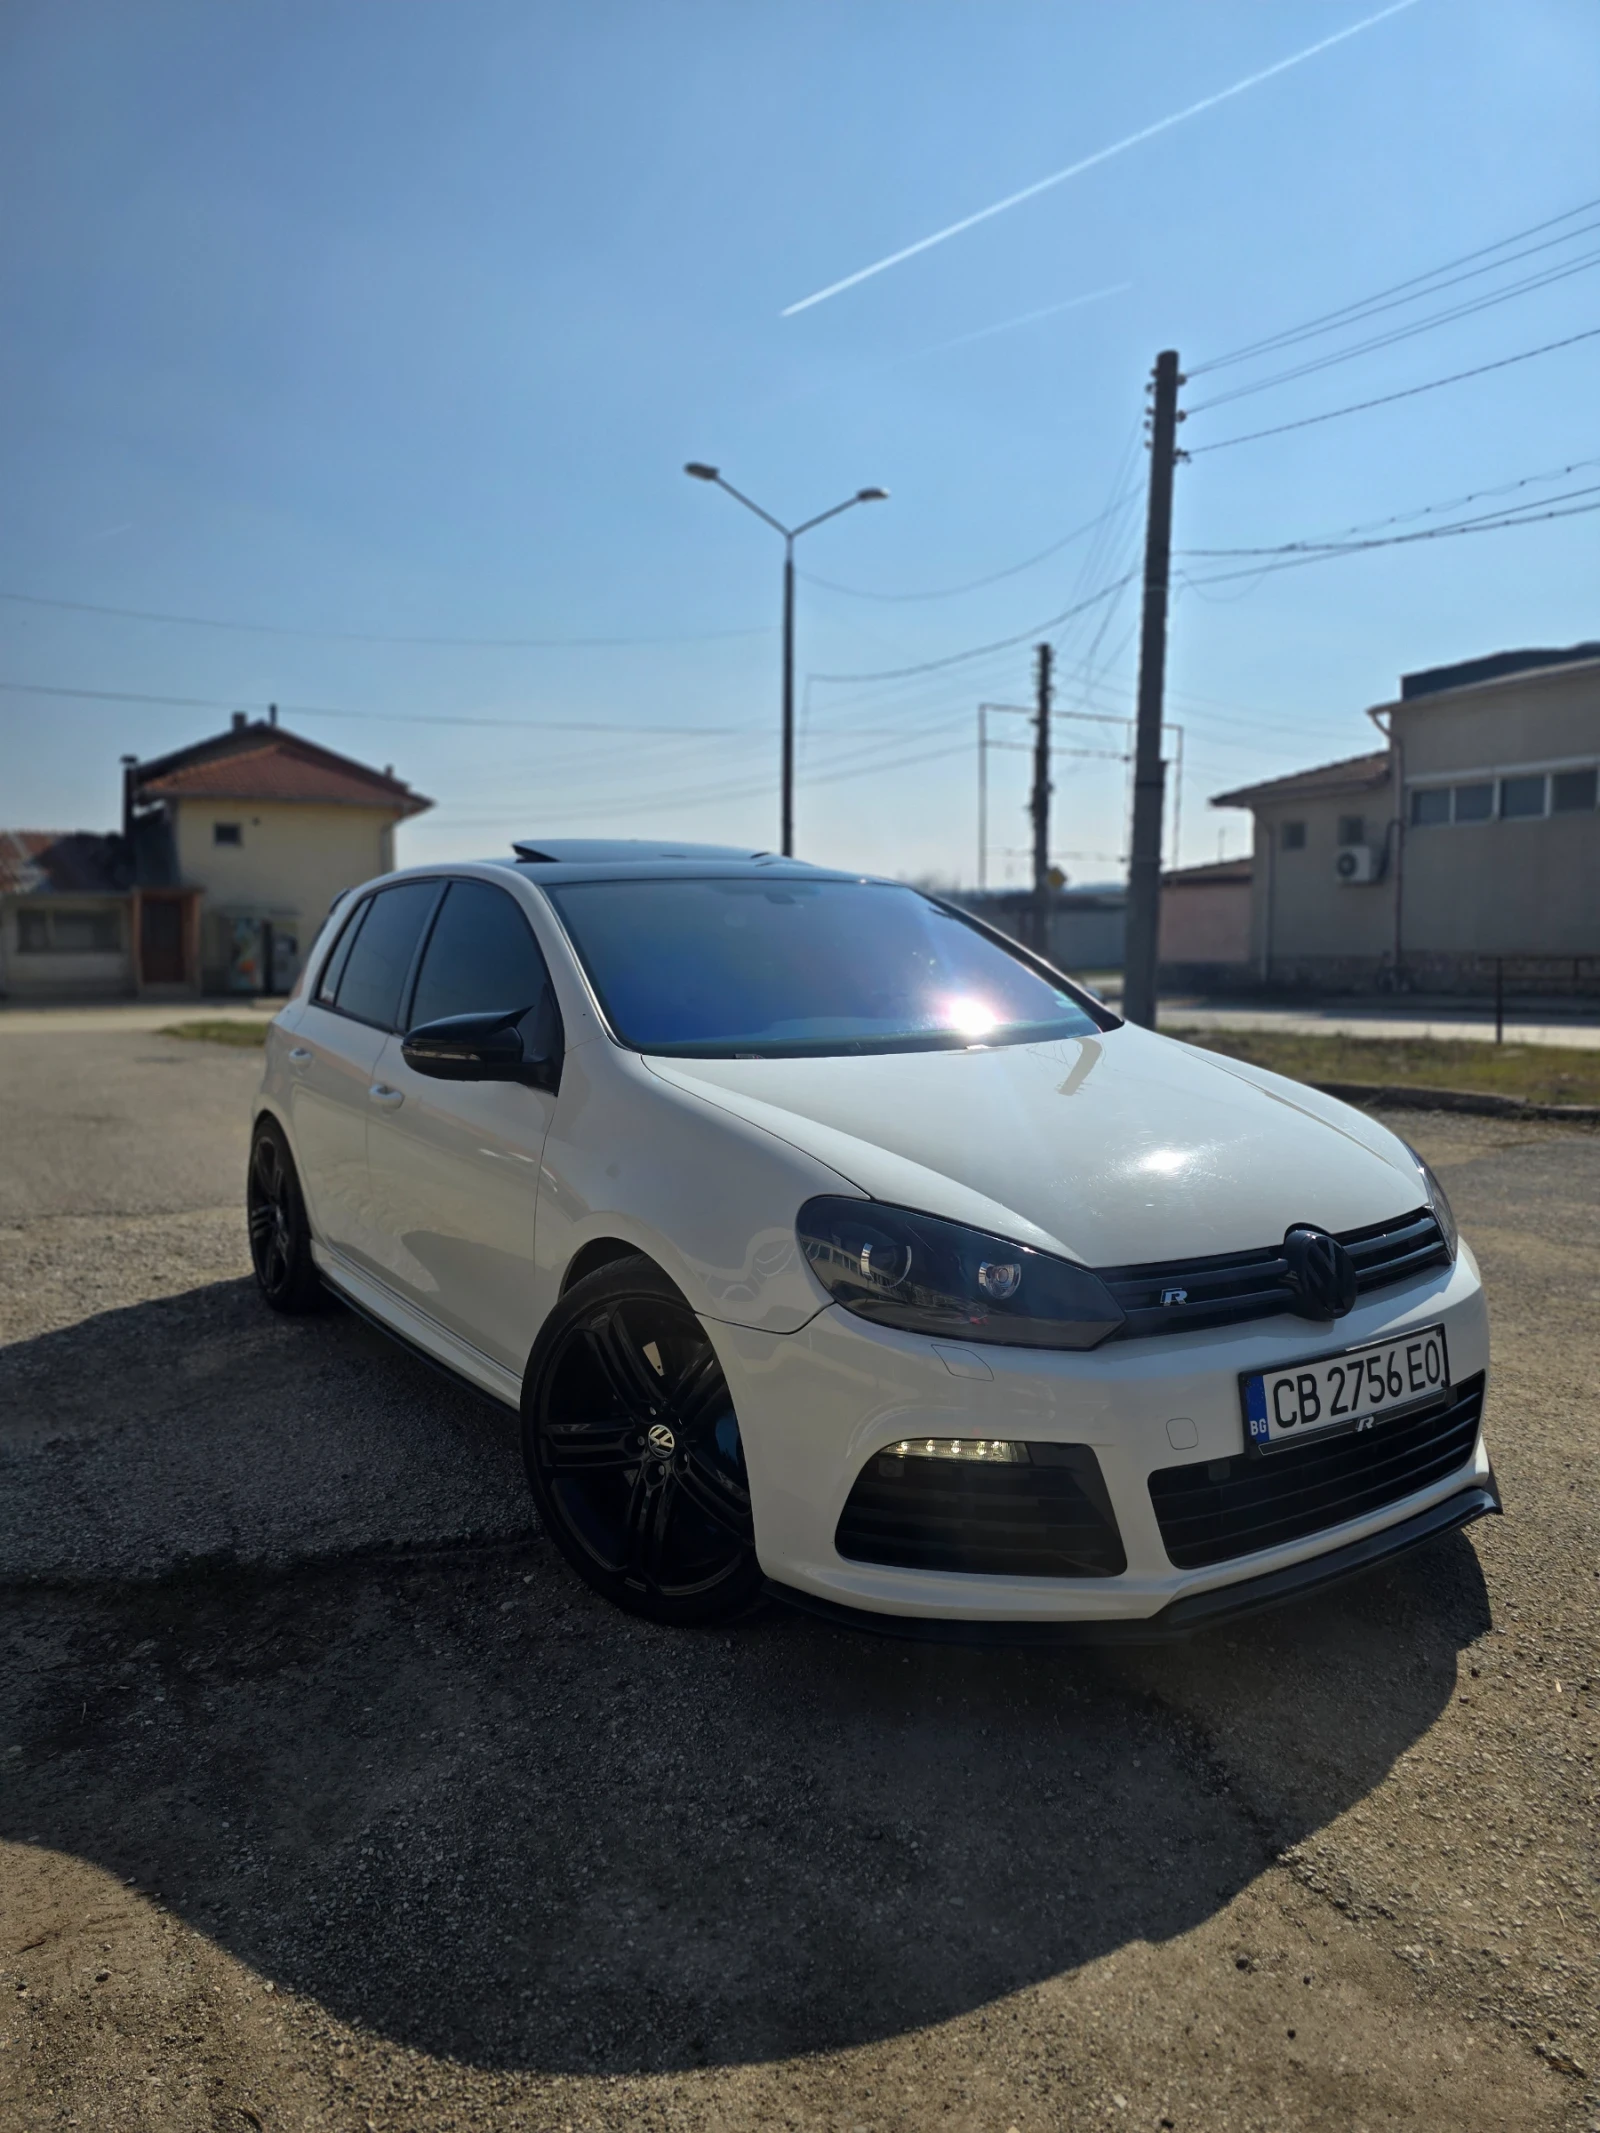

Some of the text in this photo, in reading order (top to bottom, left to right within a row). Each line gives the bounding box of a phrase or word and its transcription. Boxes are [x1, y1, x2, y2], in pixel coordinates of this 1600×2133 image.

[1160, 1287, 1187, 1306] R
[1273, 1373, 1321, 1429] CB
[1327, 1351, 1403, 1417] 2756
[1250, 1418, 1267, 1437] BG
[1355, 1414, 1375, 1432] R
